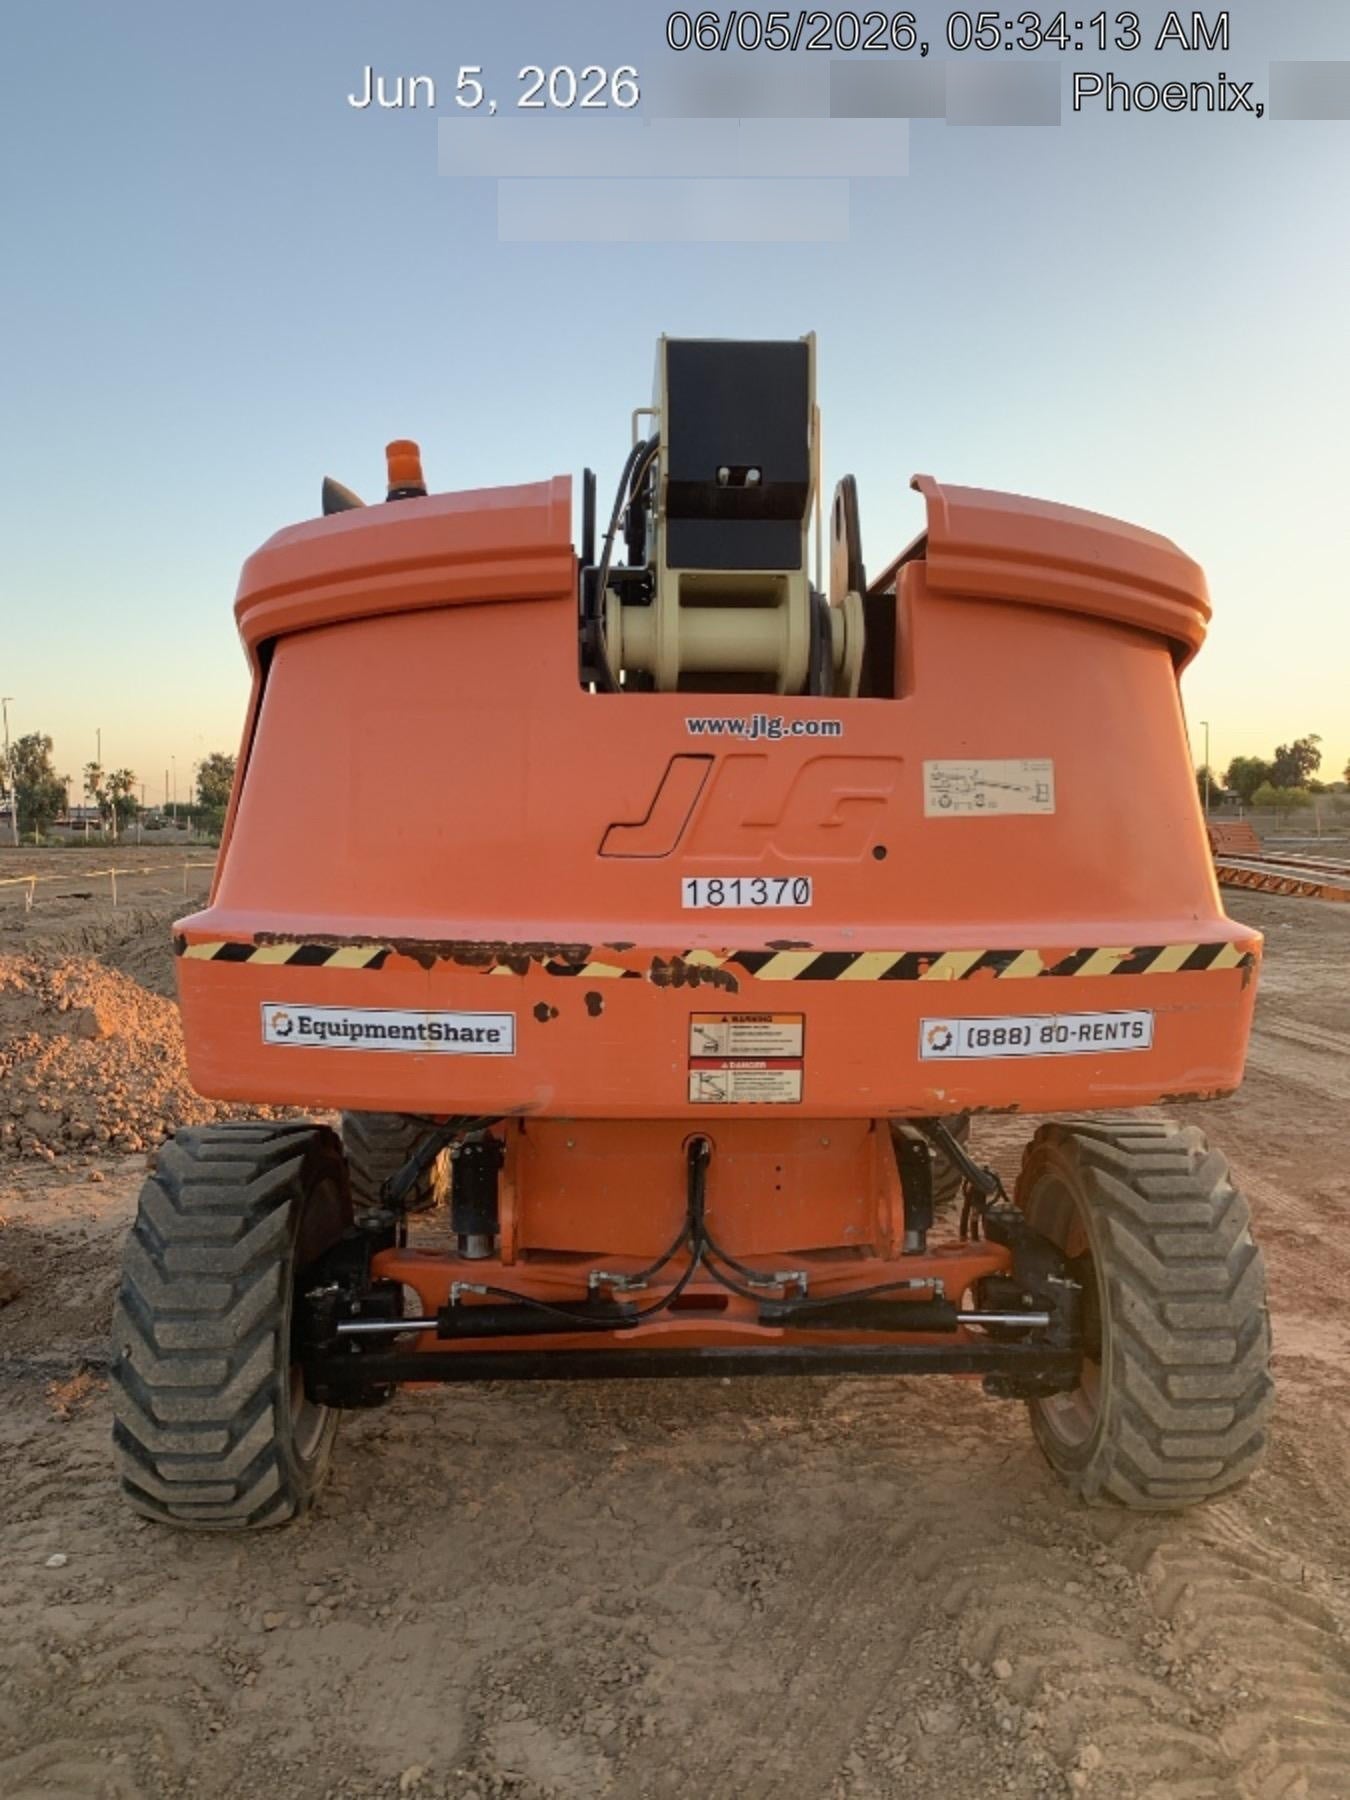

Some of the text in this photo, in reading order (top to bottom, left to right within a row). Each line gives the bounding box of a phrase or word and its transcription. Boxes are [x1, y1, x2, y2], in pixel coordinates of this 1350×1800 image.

[686, 715, 842, 739] www.jlg.com
[598, 753, 904, 862] JLG
[685, 878, 811, 907] 181370
[297, 1016, 501, 1043] EquipmentShare
[966, 1021, 1144, 1048] (888) 80-RENTS
